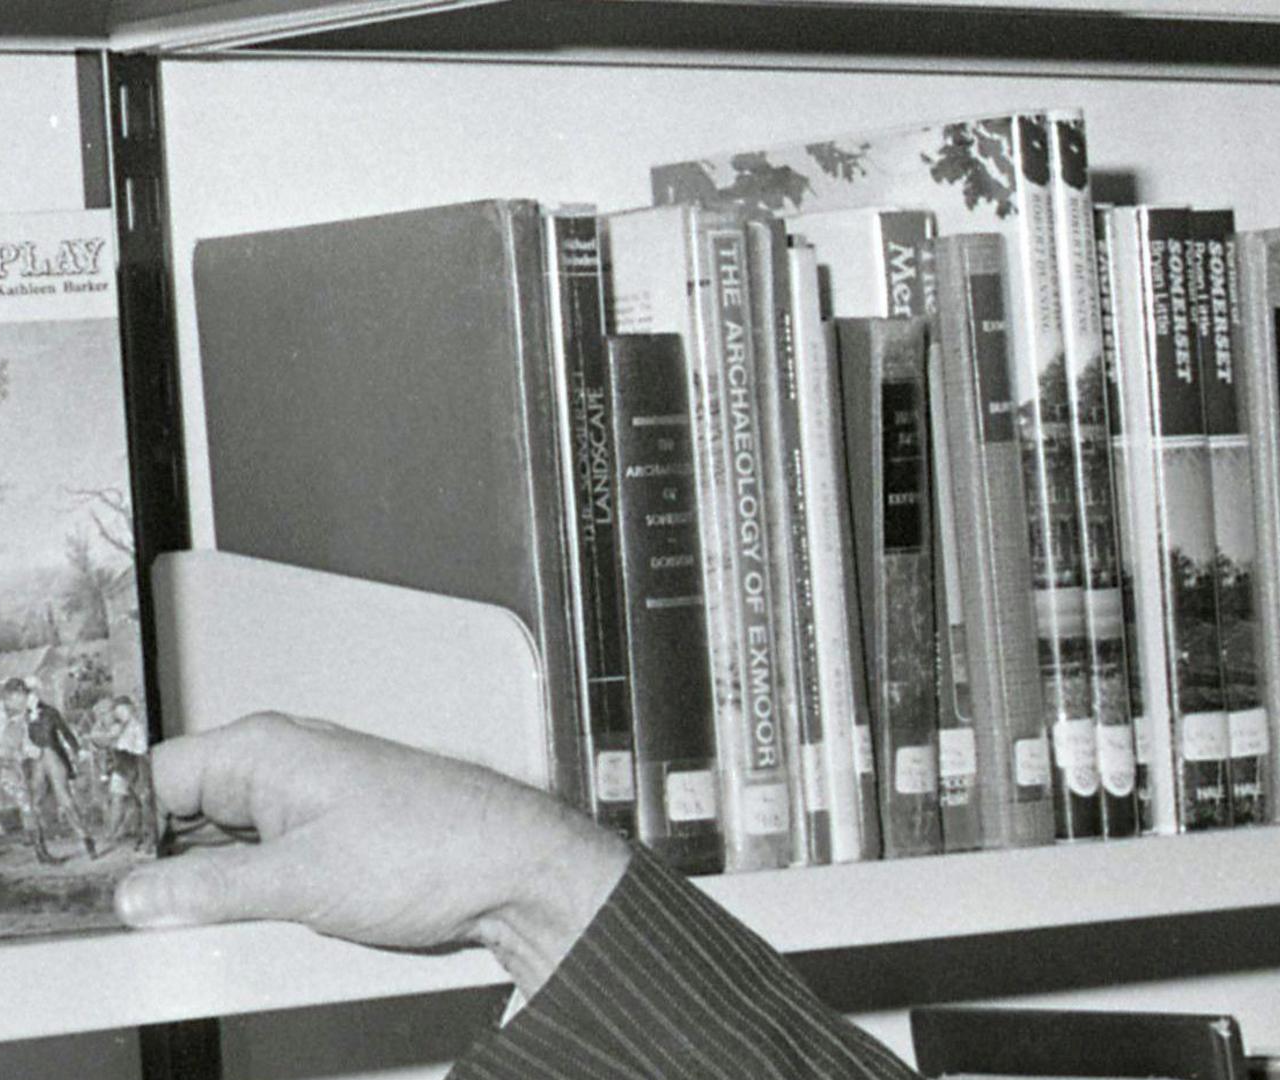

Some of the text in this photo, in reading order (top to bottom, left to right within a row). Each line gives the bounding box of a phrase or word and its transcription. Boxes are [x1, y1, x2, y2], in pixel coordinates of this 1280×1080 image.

[63, 280, 109, 295] Barker
[1151, 240, 1169, 335] Bryan Little
[1167, 238, 1193, 384] SOMERSET
[1208, 239, 1233, 384] SOMERSET
[587, 386, 613, 525] LANDSCAPE
[719, 242, 777, 767] THE ARCHAEOLOGY OF EXMOOR
